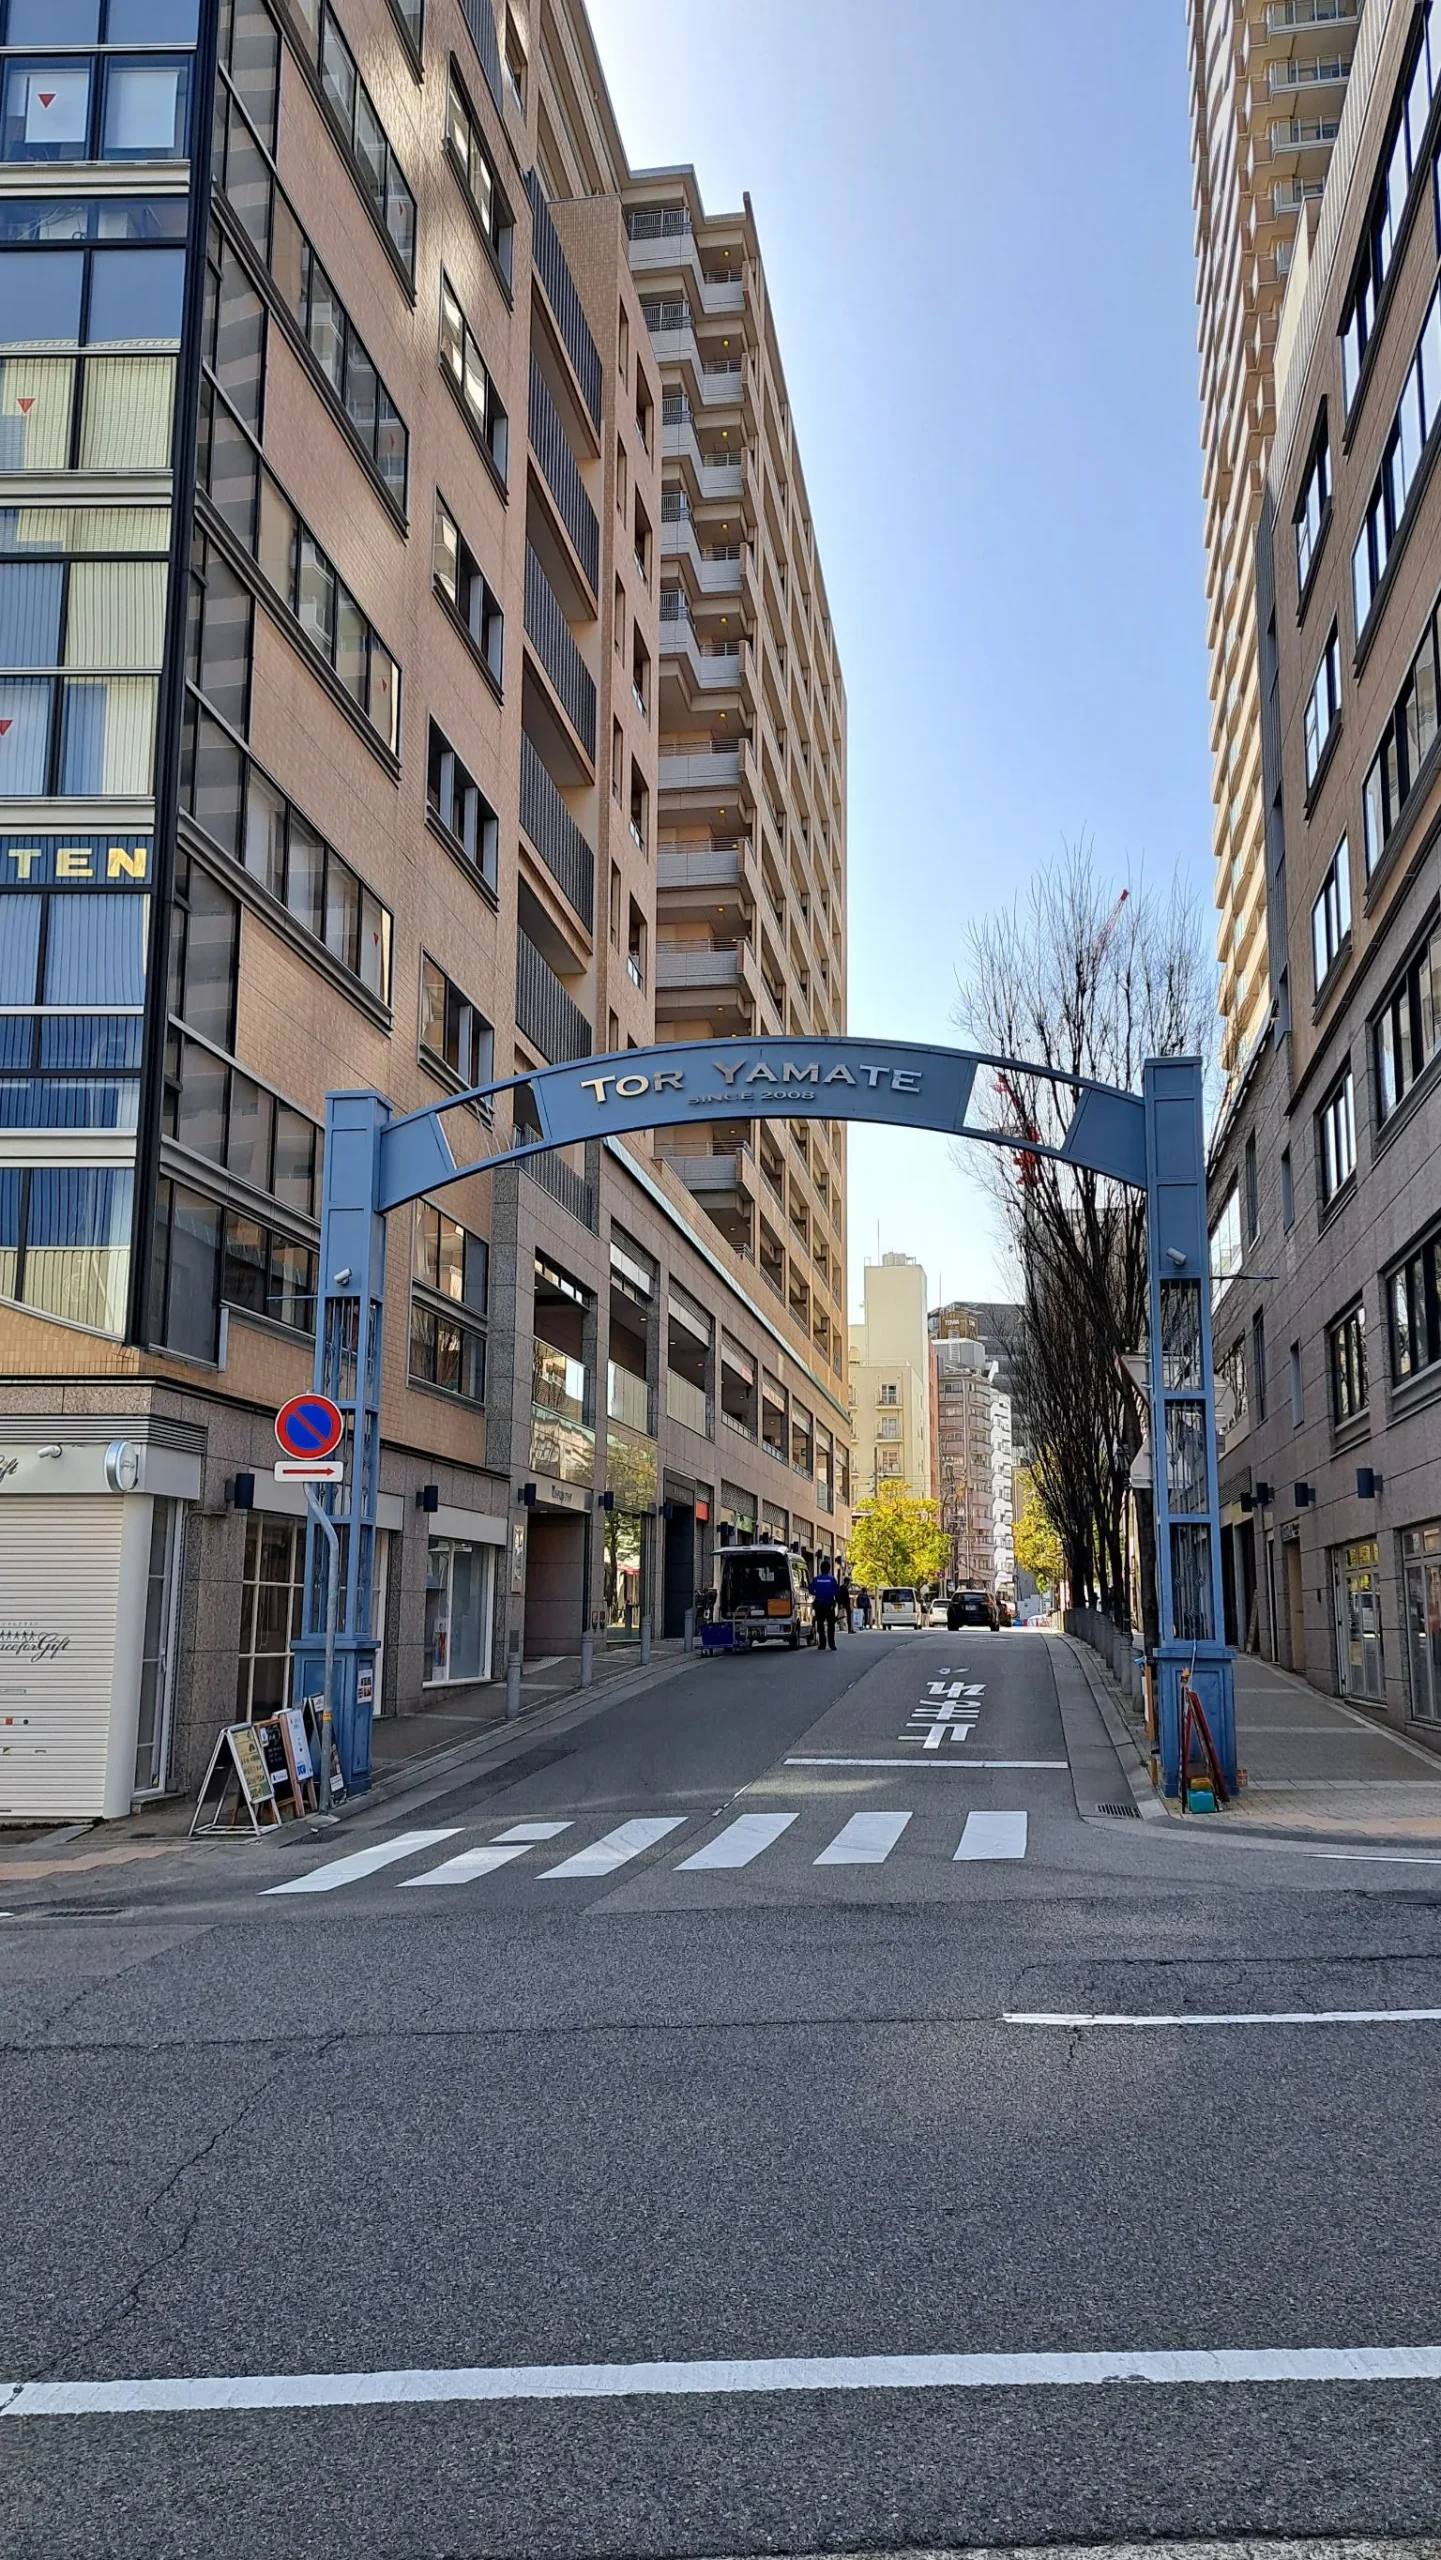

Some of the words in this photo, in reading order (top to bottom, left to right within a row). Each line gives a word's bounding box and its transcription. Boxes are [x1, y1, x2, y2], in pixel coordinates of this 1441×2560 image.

[8, 847, 148, 879] TEN
[580, 1069, 684, 1104] TOR
[711, 1060, 923, 1093] YAMATE
[687, 1091, 756, 1105] SINCE
[760, 1089, 816, 1101] 2008
